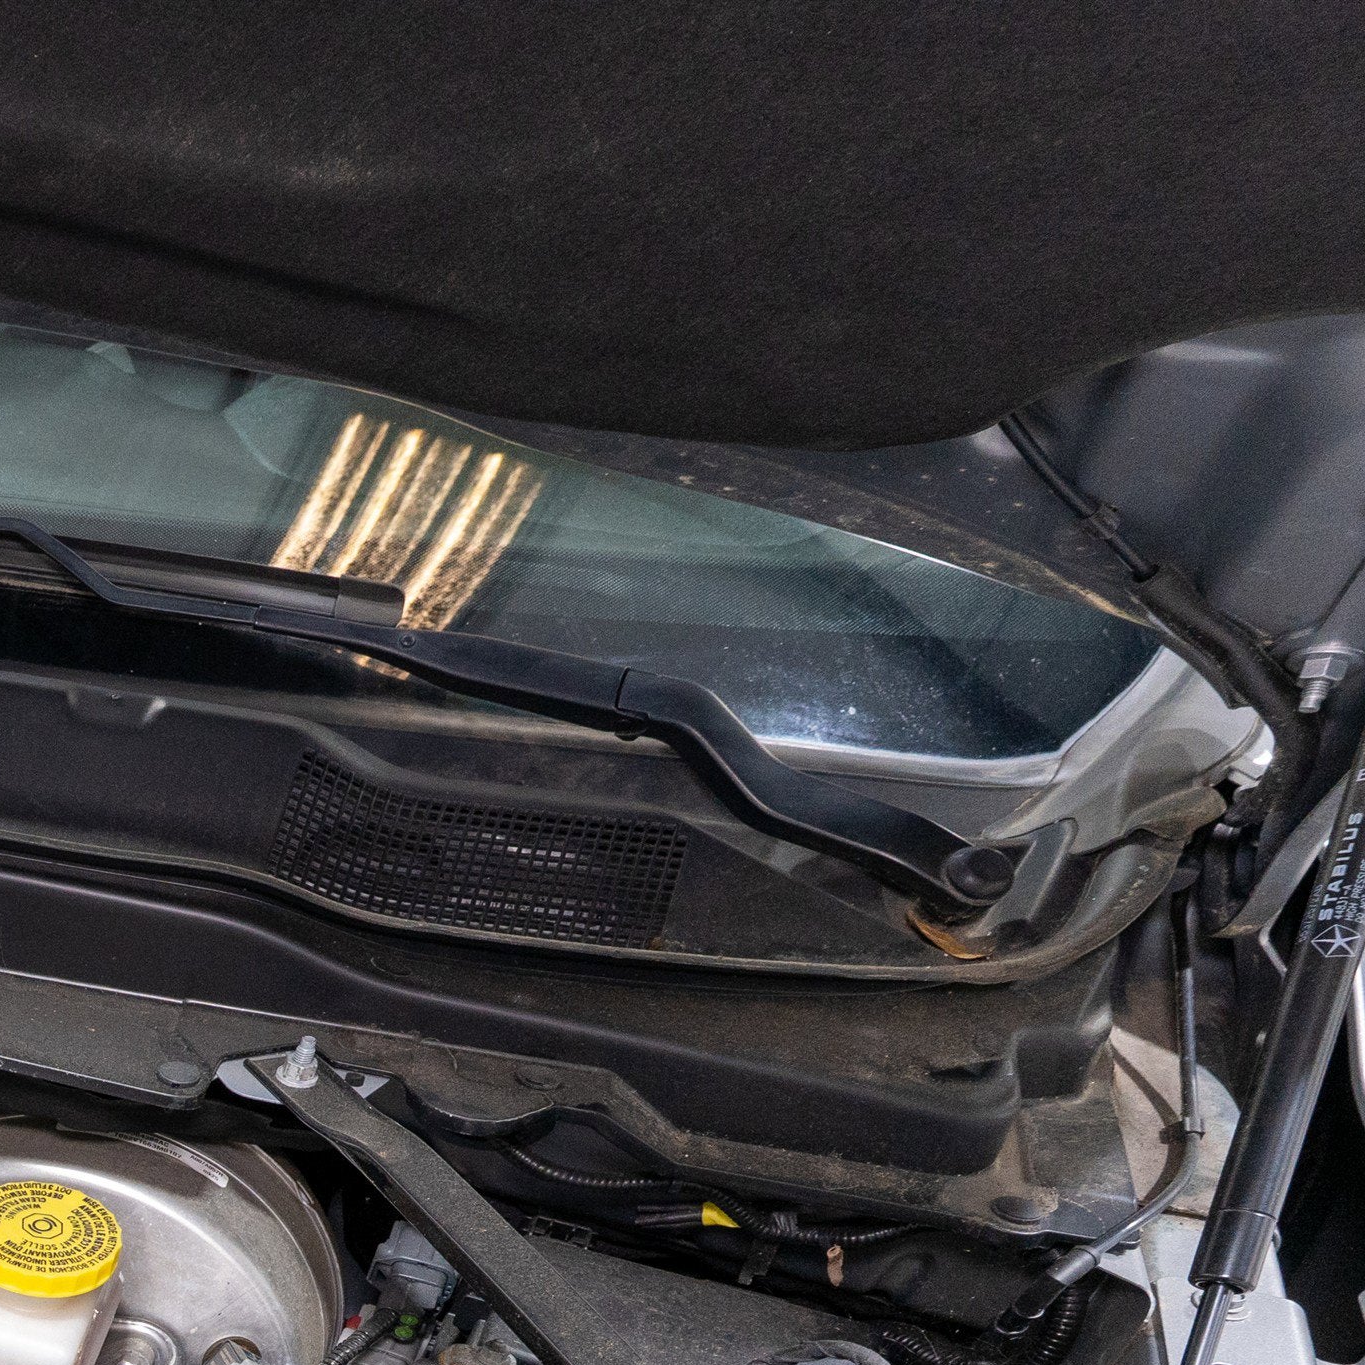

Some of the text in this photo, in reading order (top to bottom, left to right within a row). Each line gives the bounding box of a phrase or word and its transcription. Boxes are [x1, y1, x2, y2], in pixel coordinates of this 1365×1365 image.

[1319, 813, 1364, 921] STABILUS
[30, 1190, 63, 1199] BEFORE
[0, 1199, 19, 1213] FILLER
[82, 1197, 100, 1209] MISE
[78, 1205, 100, 1220] AVANT
[97, 1208, 108, 1216] EN
[60, 1216, 81, 1249] CONTENANT
[78, 1238, 91, 1249] DOT
[22, 1249, 76, 1258] PROVENANT
[49, 1255, 85, 1266] UTILISER
[49, 1263, 89, 1273] BOUCHON
